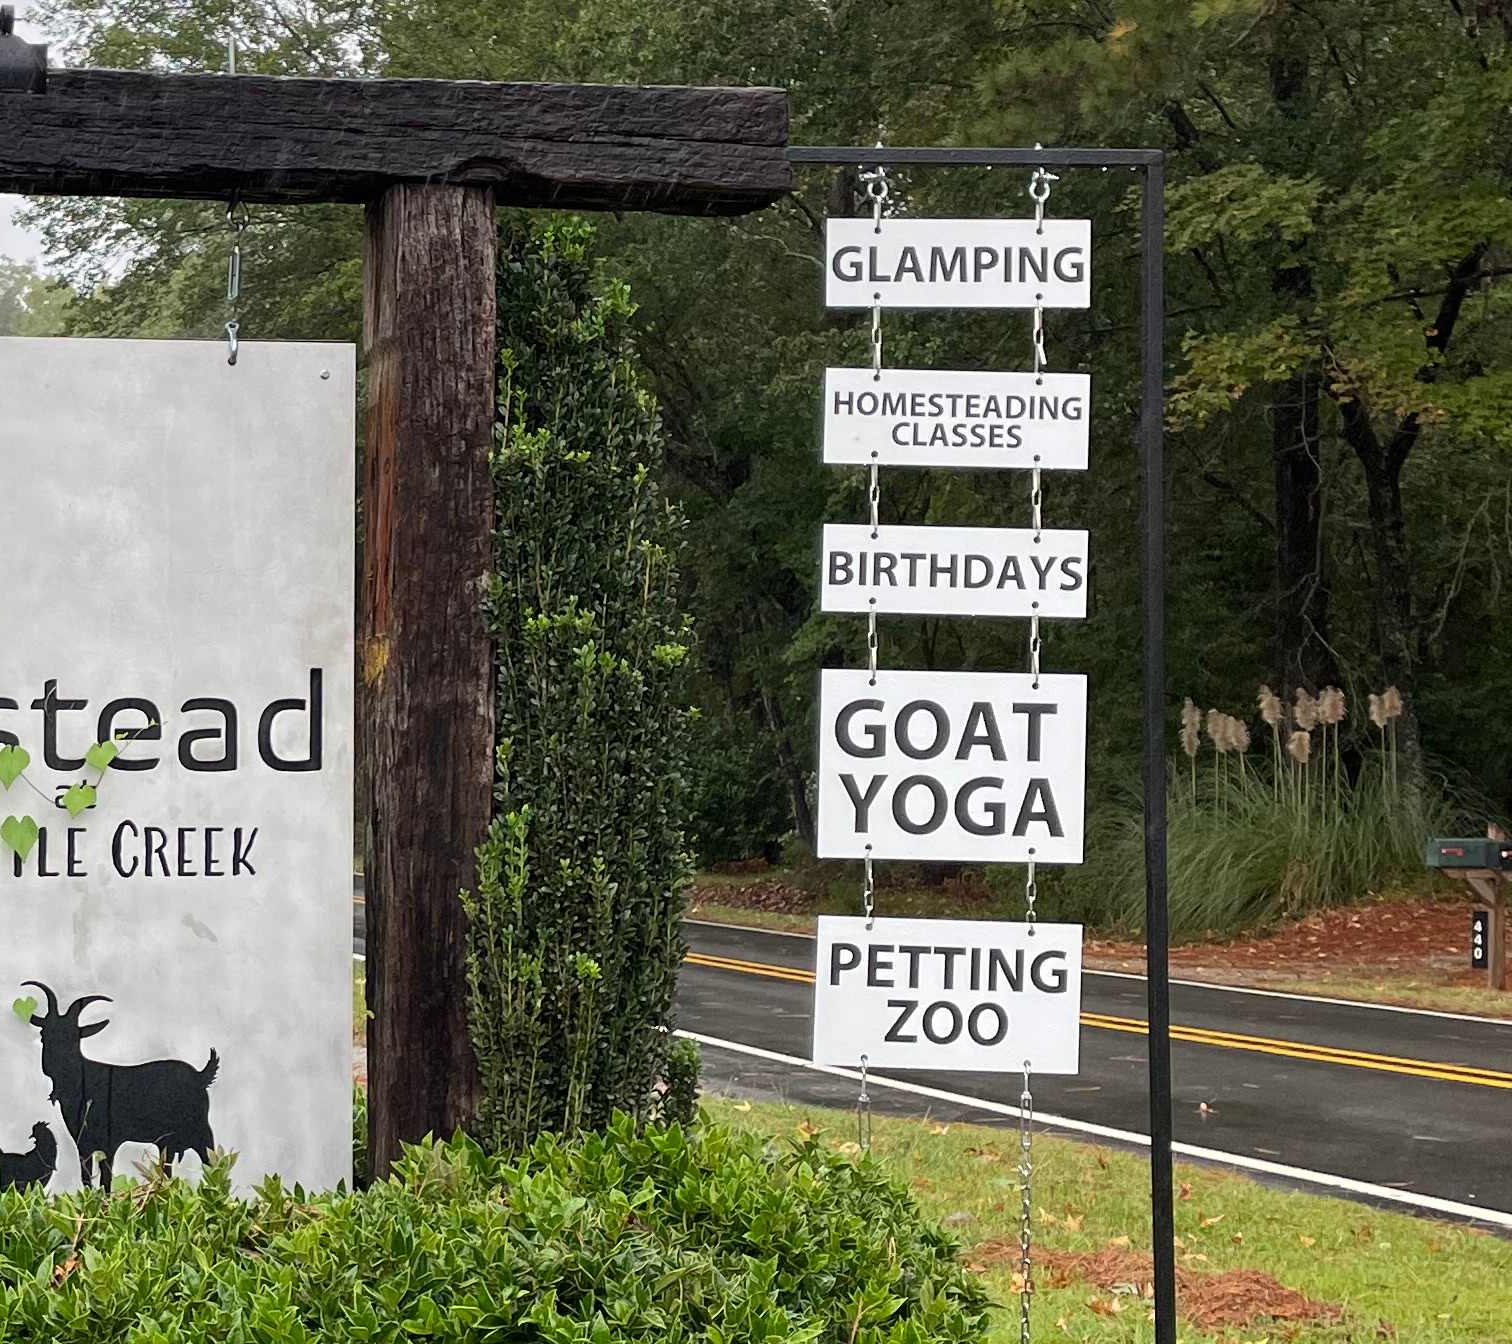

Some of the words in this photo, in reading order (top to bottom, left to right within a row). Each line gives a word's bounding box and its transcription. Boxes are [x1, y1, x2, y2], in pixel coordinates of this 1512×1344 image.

[832, 245, 1085, 283] GLAMPING
[833, 391, 1083, 420] HOMESTEADING
[891, 422, 1023, 449] CLASSES
[828, 550, 1084, 592] BIRTHDAYS
[834, 698, 1059, 763] GOAT
[838, 773, 1066, 839] YOGA
[111, 819, 259, 878] CREEK
[1473, 919, 1483, 960] 440
[829, 942, 1068, 994] PETTING
[884, 999, 1009, 1047] ZOO
